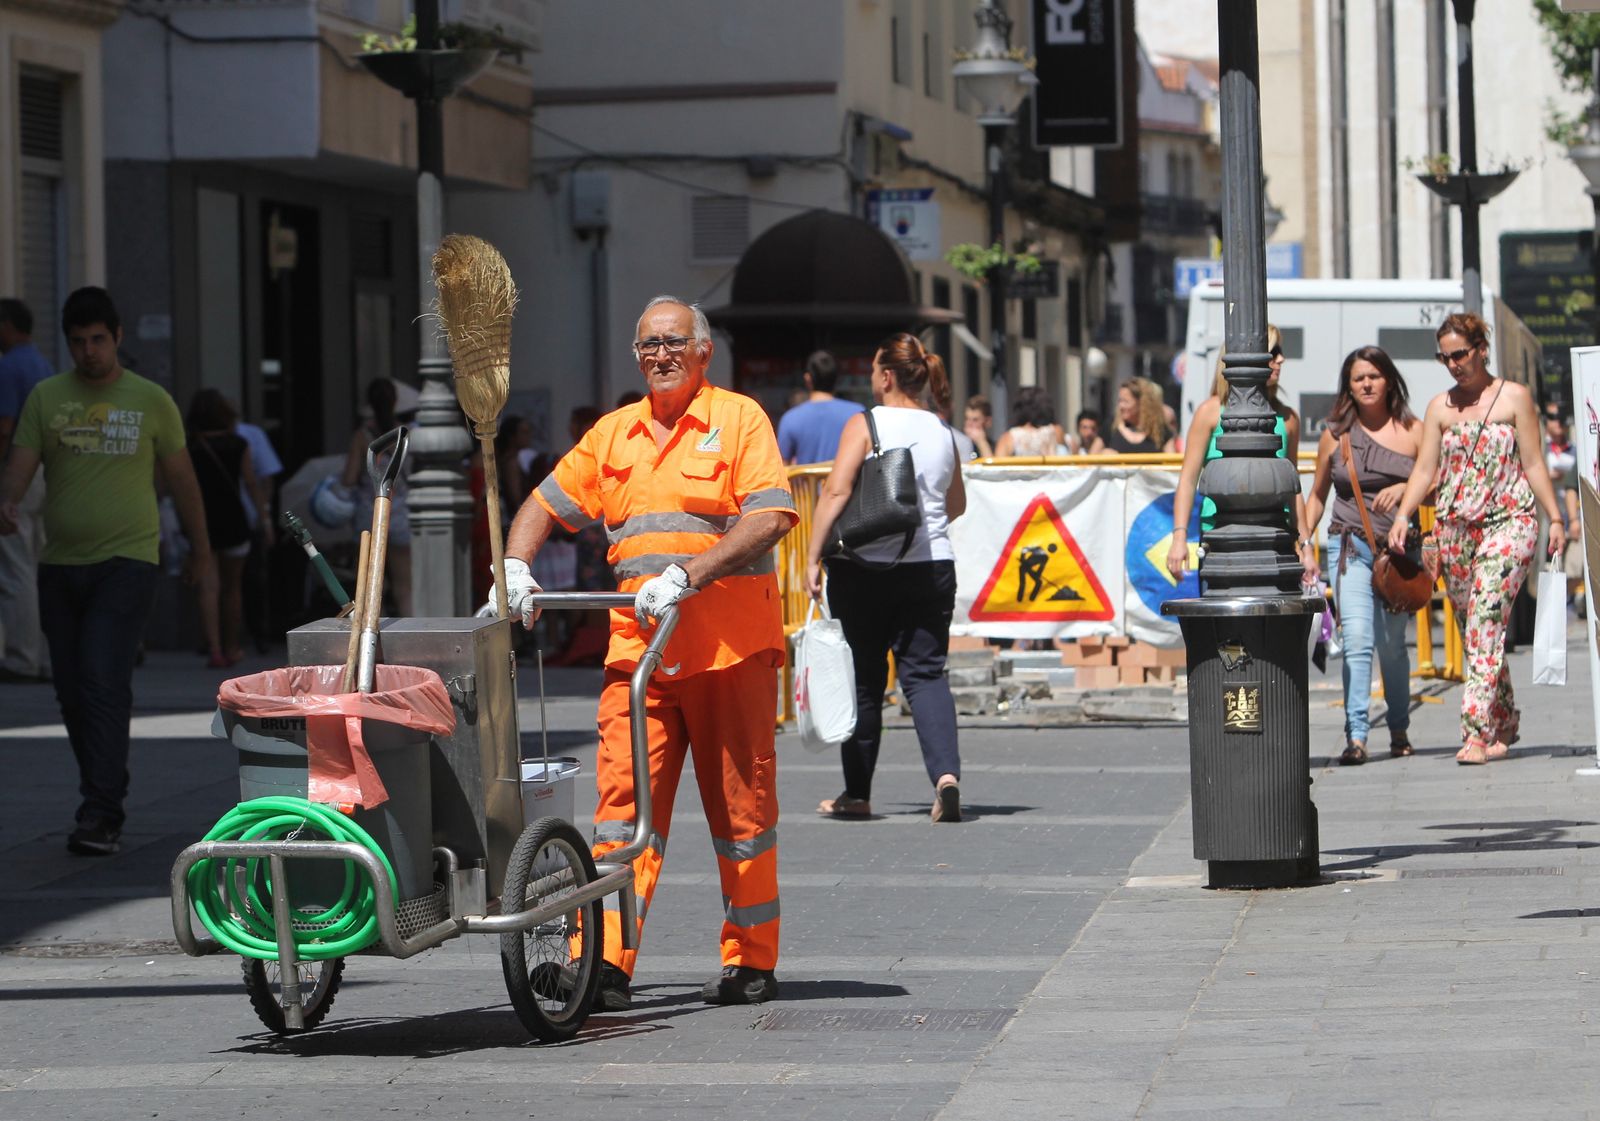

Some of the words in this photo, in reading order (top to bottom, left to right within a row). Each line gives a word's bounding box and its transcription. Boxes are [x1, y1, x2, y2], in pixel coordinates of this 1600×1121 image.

[108, 409, 144, 425] WEST
[105, 424, 140, 440] WIND
[104, 440, 138, 455] CLUB
